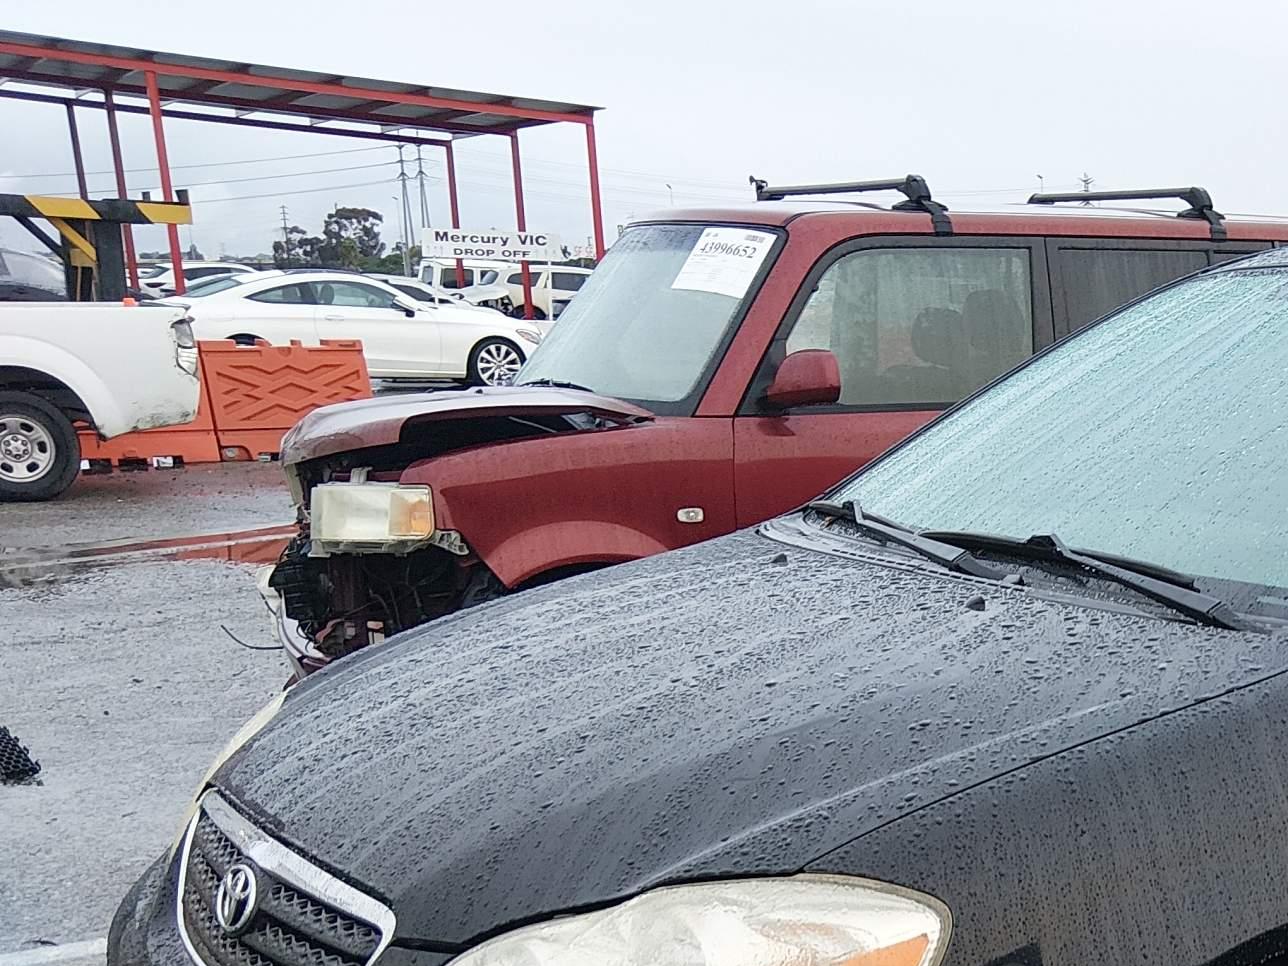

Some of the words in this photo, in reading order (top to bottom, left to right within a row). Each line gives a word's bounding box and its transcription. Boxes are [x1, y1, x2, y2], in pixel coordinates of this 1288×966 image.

[435, 231, 509, 247] Mercury
[517, 234, 548, 246] VIC
[453, 248, 495, 257] DROP
[501, 249, 531, 258] OFF
[700, 241, 757, 258] 43996652
